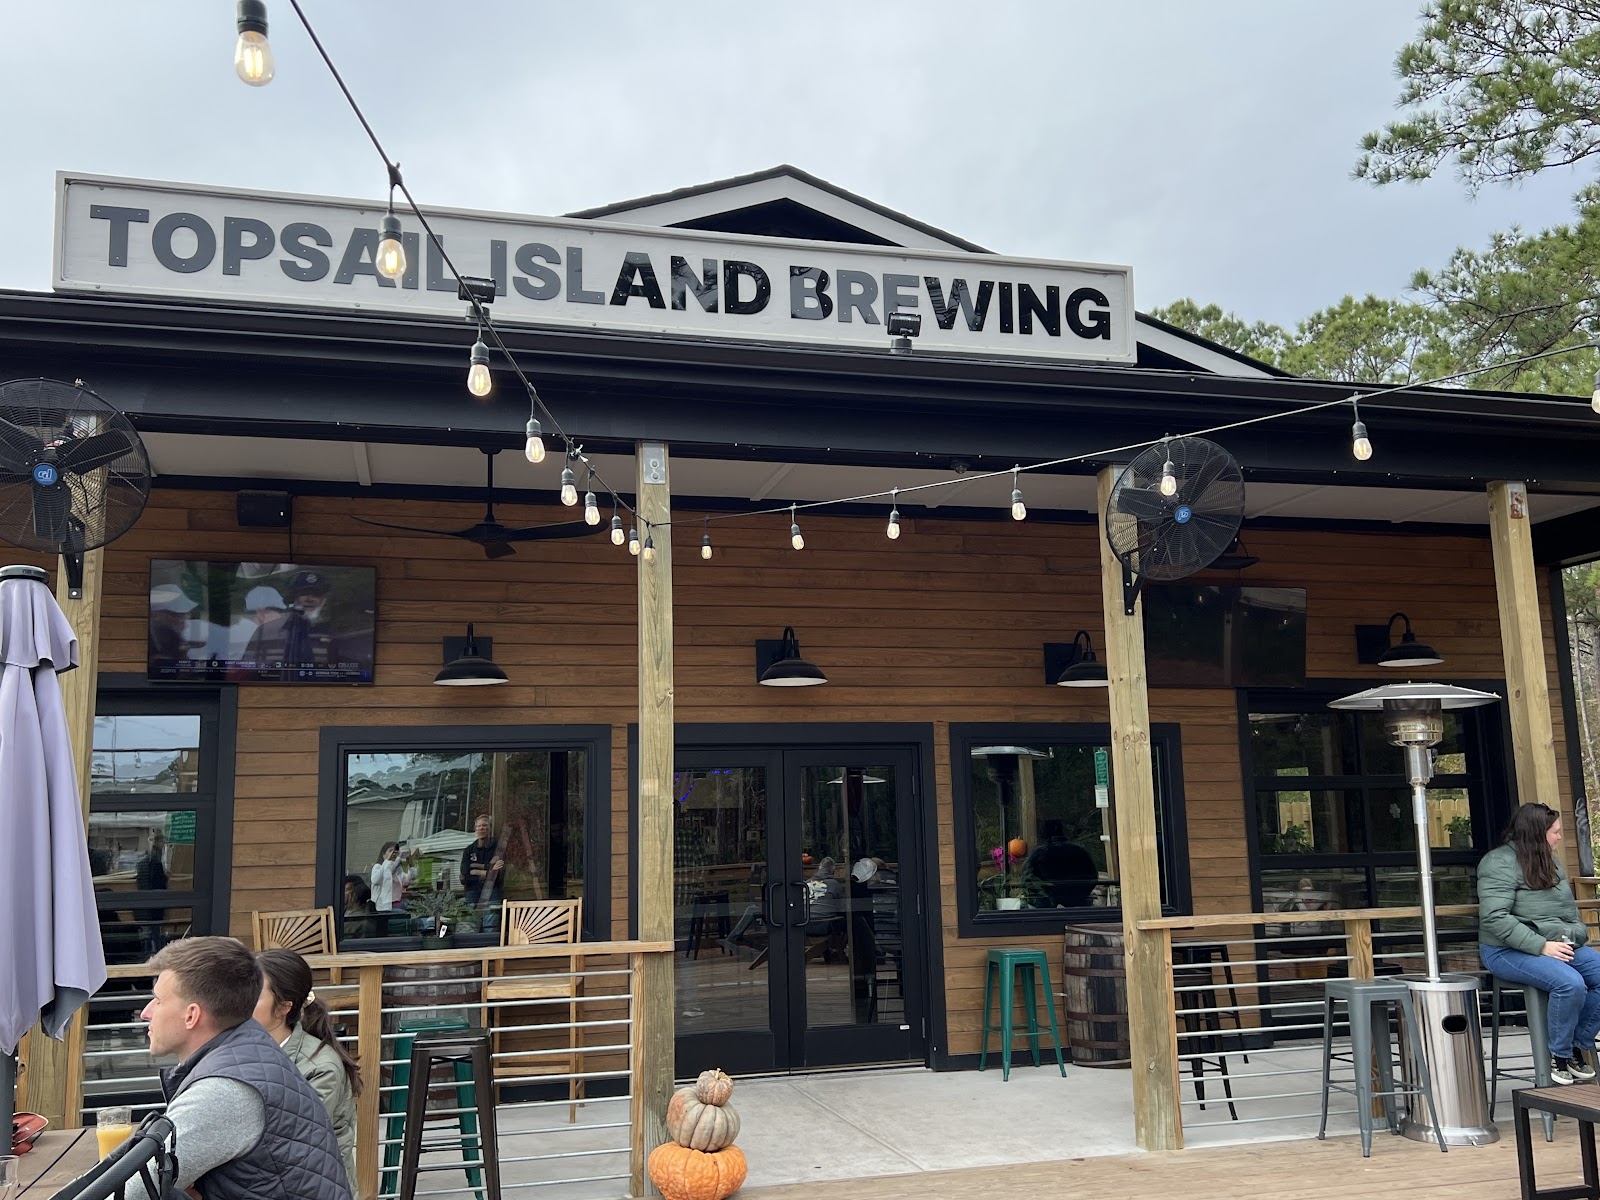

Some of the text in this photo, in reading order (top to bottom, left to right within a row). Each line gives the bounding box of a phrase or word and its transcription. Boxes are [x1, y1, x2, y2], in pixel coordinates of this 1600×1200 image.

[89, 204, 1111, 340] TOPSAIL ISLAND BREWING
